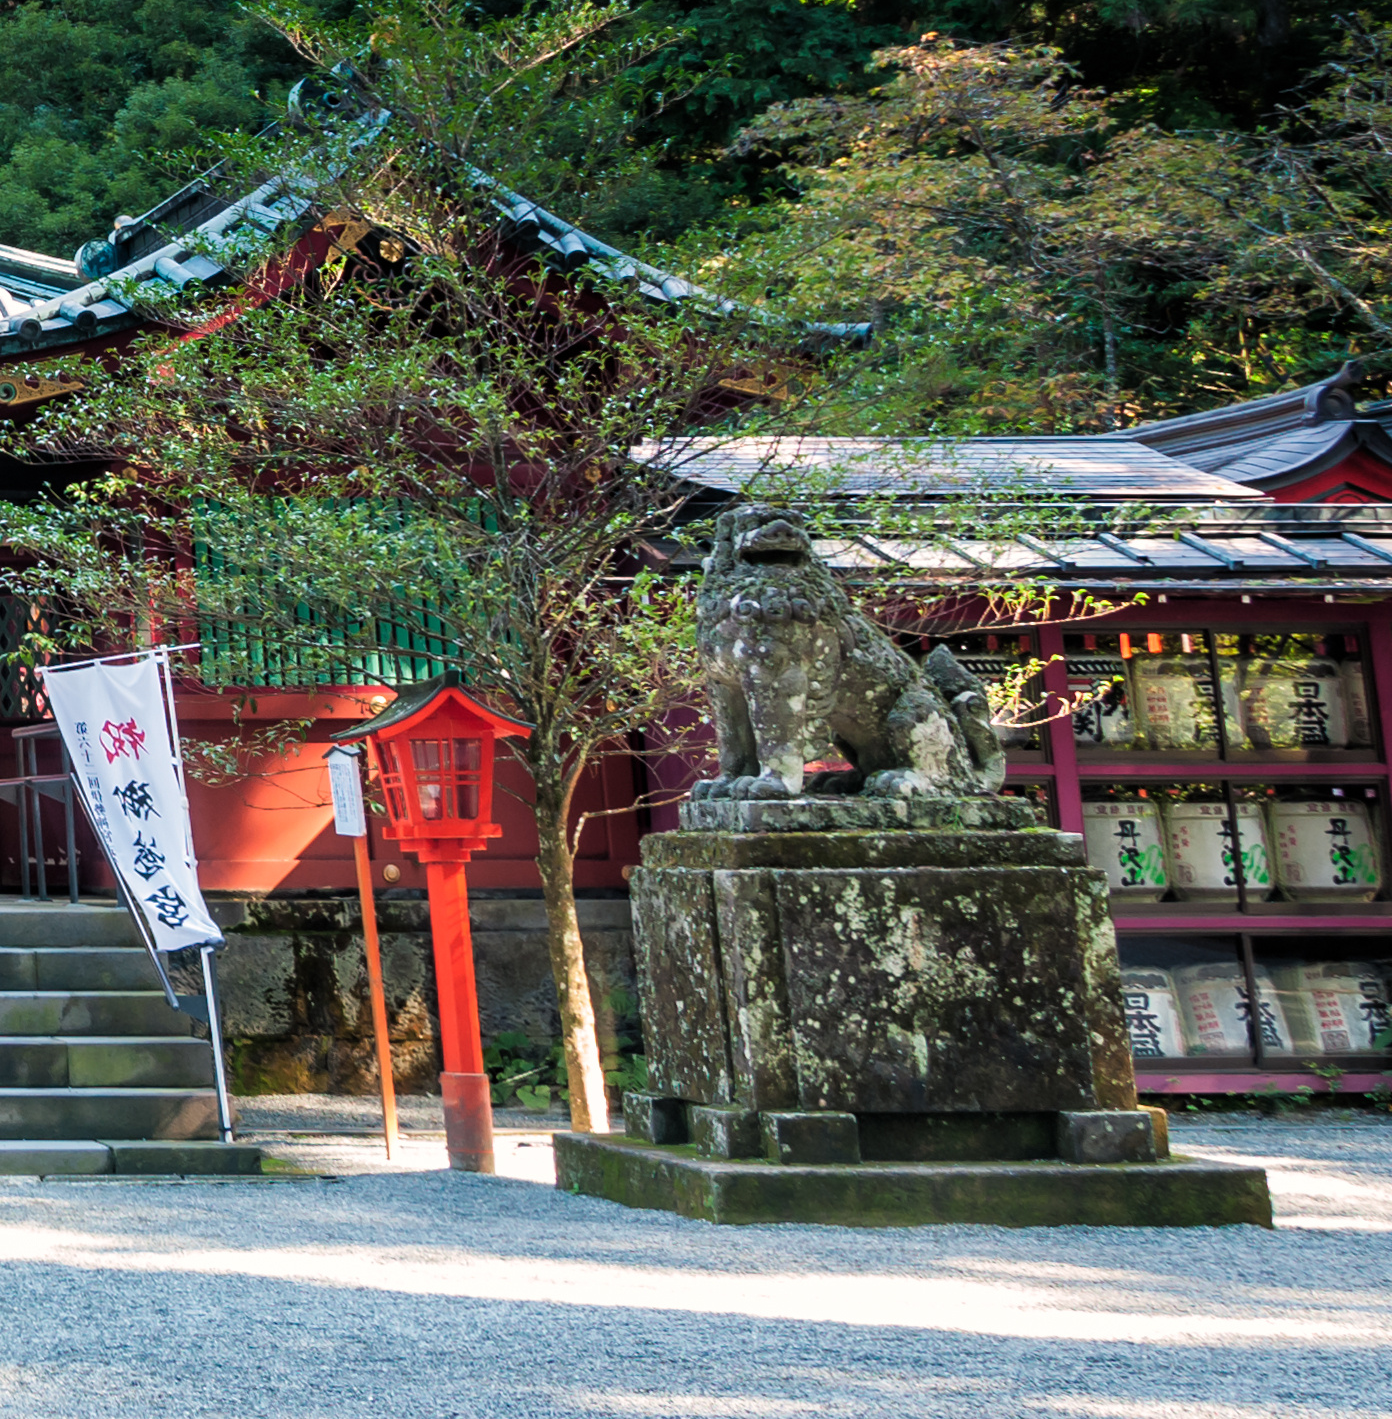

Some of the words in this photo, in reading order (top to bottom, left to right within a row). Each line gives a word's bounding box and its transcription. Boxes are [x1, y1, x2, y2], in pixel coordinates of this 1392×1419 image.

[1113, 819, 1145, 886] 丹沢山
[1324, 818, 1357, 885] 丹沢山
